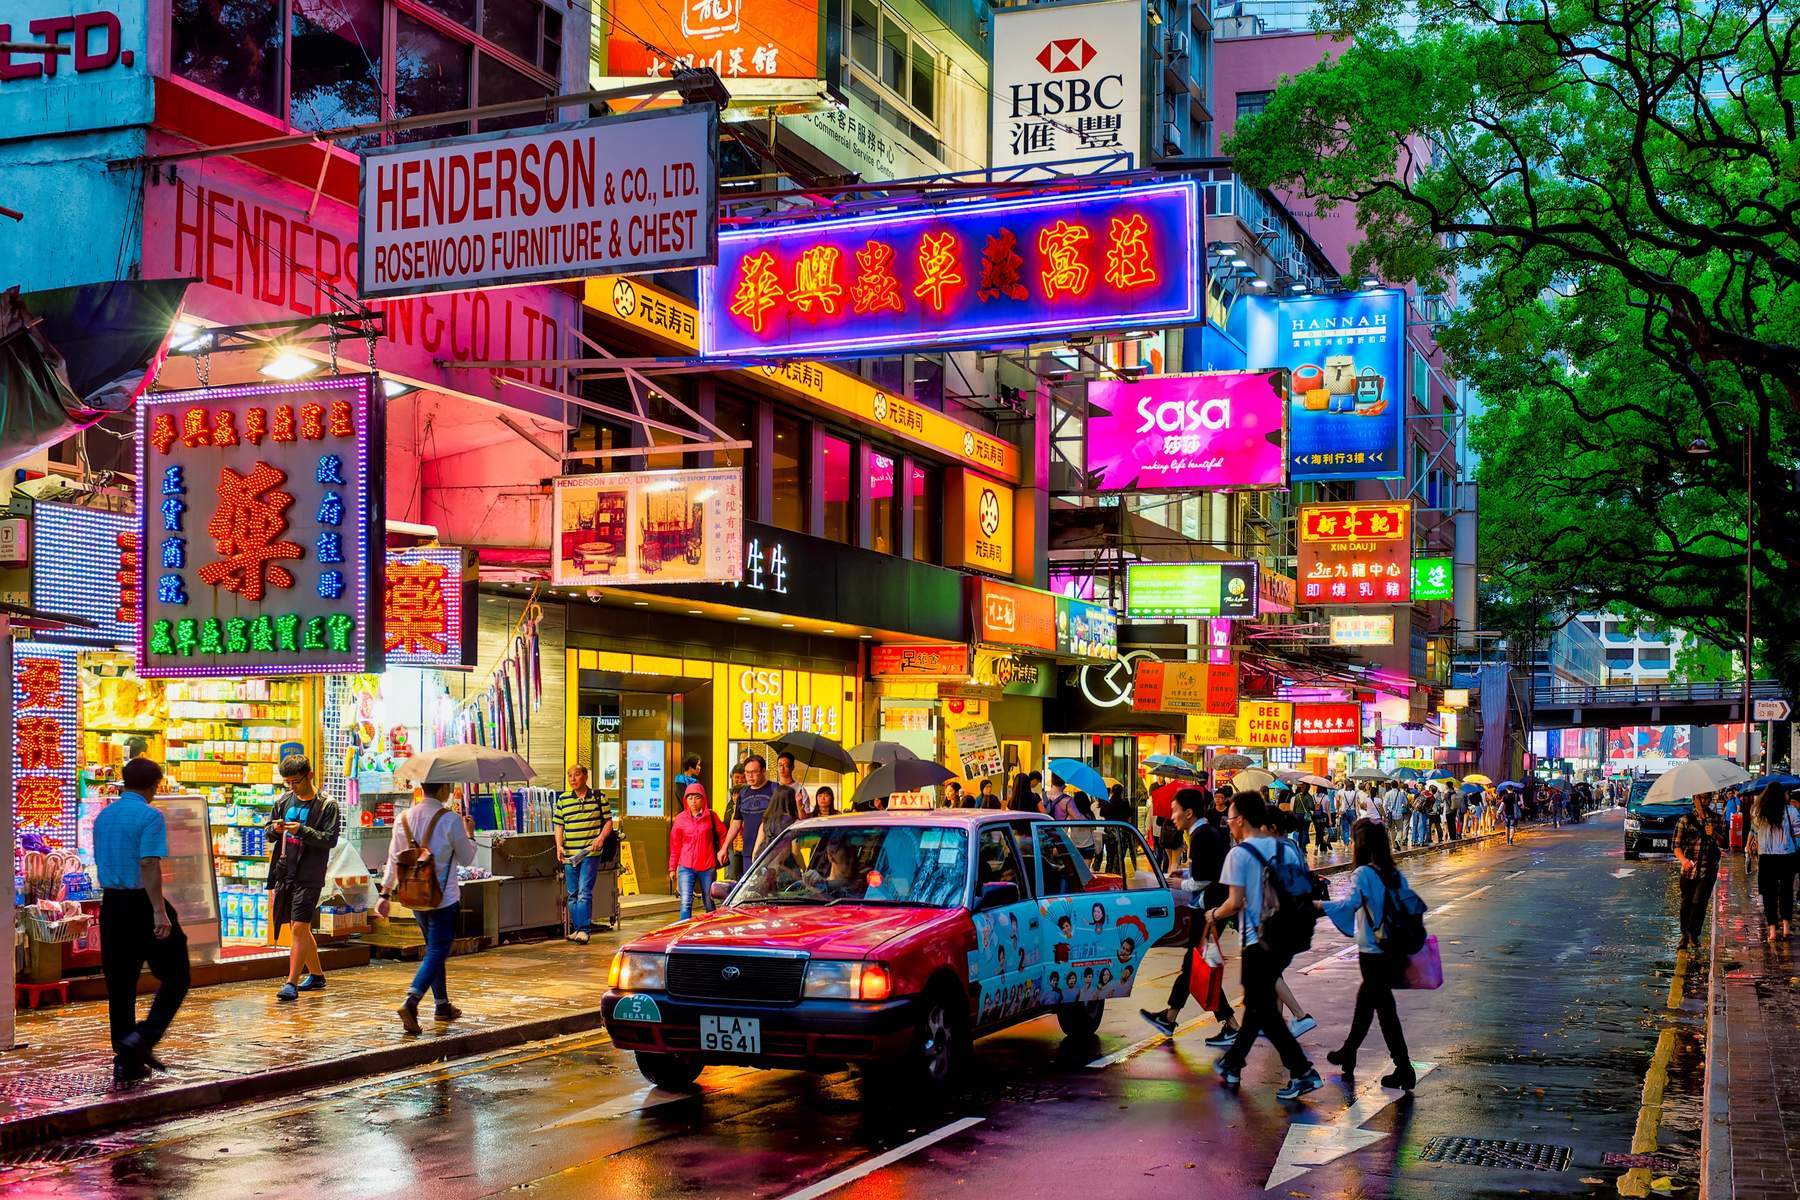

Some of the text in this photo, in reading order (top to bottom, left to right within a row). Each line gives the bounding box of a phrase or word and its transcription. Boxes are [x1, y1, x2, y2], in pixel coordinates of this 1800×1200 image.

[0, 11, 134, 81] LTD.
[1009, 74, 1123, 118] HSBC
[814, 115, 895, 180] Commercial Service Centre
[377, 136, 699, 232] HENDERSON & CO., LTD.
[375, 209, 698, 283] ROSEWOOD FURNITURE & CHEST
[640, 294, 695, 340] 元気寿司
[1292, 314, 1387, 330] HANNAH
[1164, 434, 1200, 455] 莎莎
[1141, 457, 1224, 474] making life beautiful
[557, 478, 605, 488] HENDERSON
[1317, 513, 1390, 535] 新斗記
[1330, 542, 1377, 552] XIN DAU JI
[721, 538, 788, 594] 生生
[1334, 562, 1400, 578] 九龍中心
[1306, 582, 1400, 597] 即燒乳豬
[741, 670, 780, 696] CSS
[1258, 707, 1280, 717] BEE
[1249, 720, 1289, 731] CHENG
[1250, 734, 1287, 744] HIANG
[17, 657, 63, 849] 免稅藥
[891, 795, 924, 806] TAXI
[623, 1012, 652, 1020] SEATS
[632, 1001, 642, 1013] 5
[717, 1016, 742, 1034] LA
[705, 1033, 756, 1053] 9641
